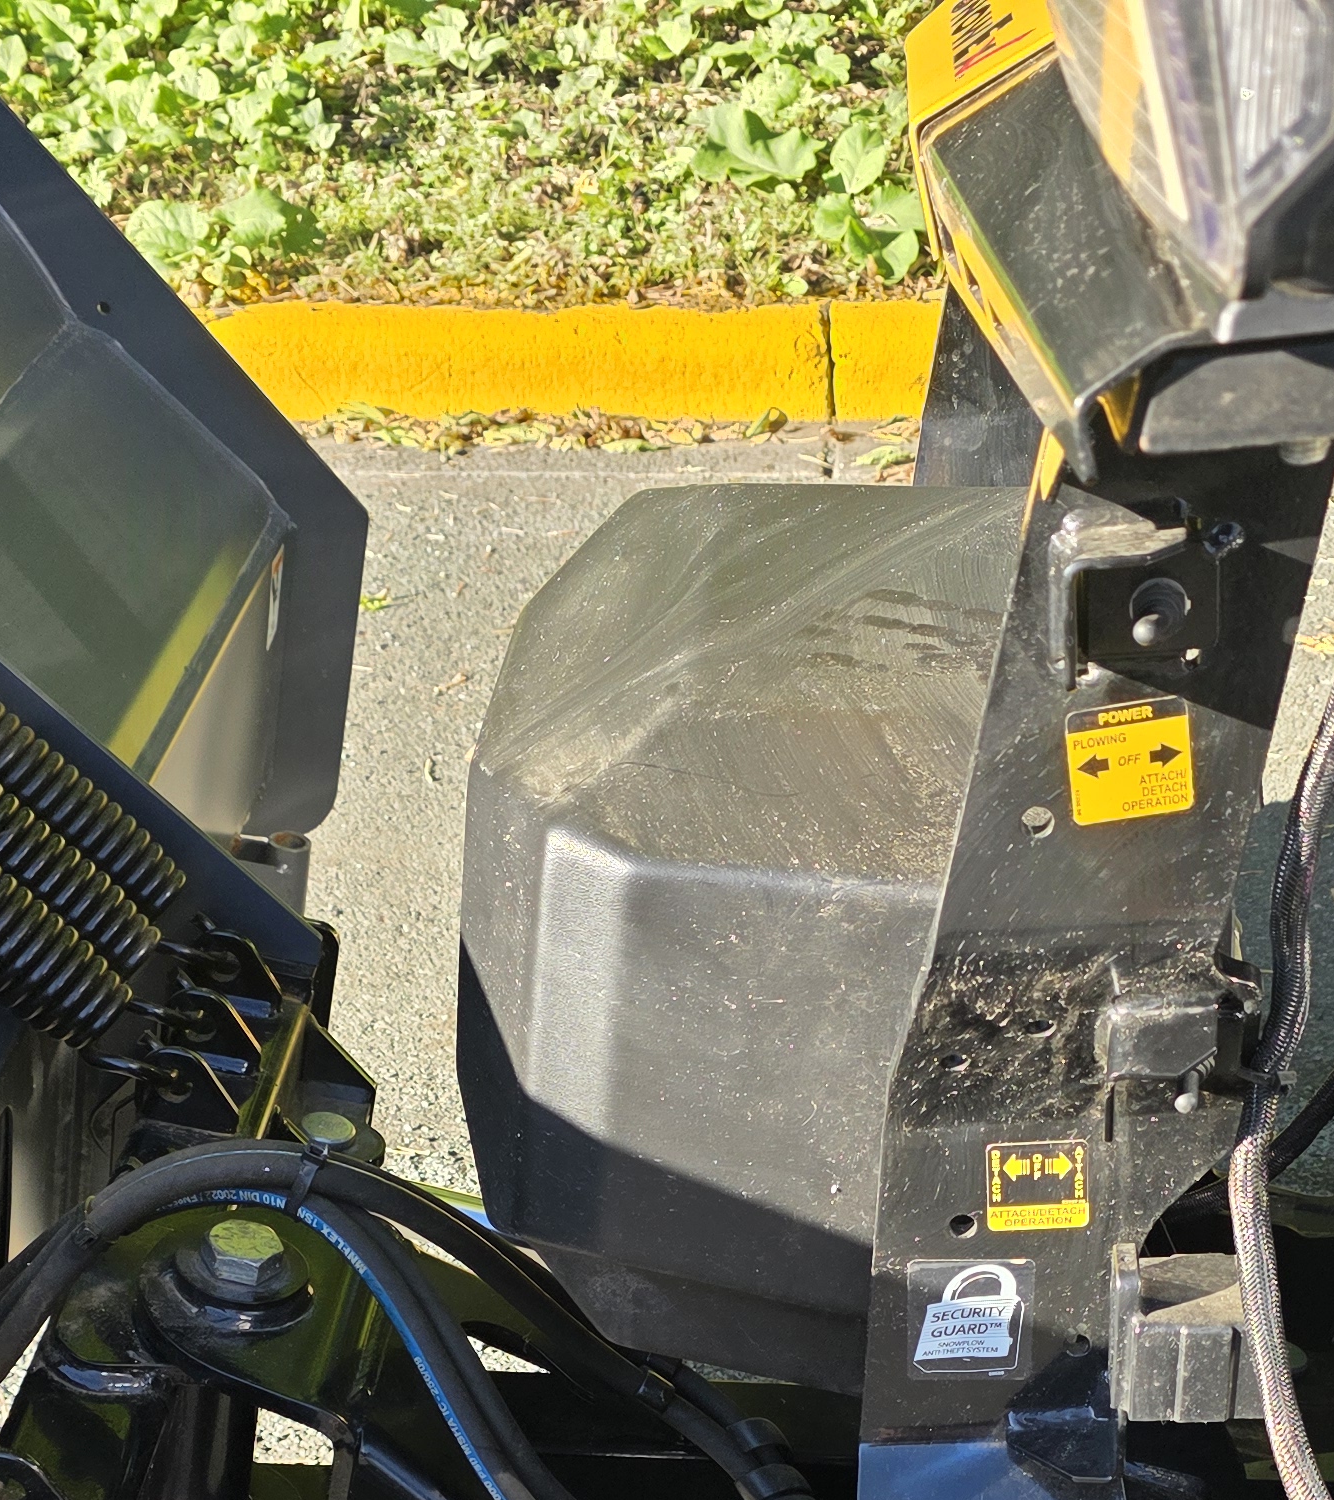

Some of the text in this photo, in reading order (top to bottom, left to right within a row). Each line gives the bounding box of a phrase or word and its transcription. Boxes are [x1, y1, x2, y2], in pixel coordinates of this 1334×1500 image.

[1098, 705, 1153, 725] POWER
[1073, 733, 1127, 750] PLOWING
[1118, 753, 1142, 767] OFF
[1139, 768, 1187, 786] ATTACH/
[1142, 782, 1188, 797] DETACH
[1122, 793, 1188, 812] OPERATION
[239, 1189, 260, 1202] DIN
[262, 1194, 287, 1209] N10
[990, 1206, 1086, 1219] ATTACH/DETACH
[1004, 1216, 1072, 1227] OPERATION
[930, 1306, 1006, 1323] SECURITY
[937, 1339, 985, 1348] SNOWPLOW
